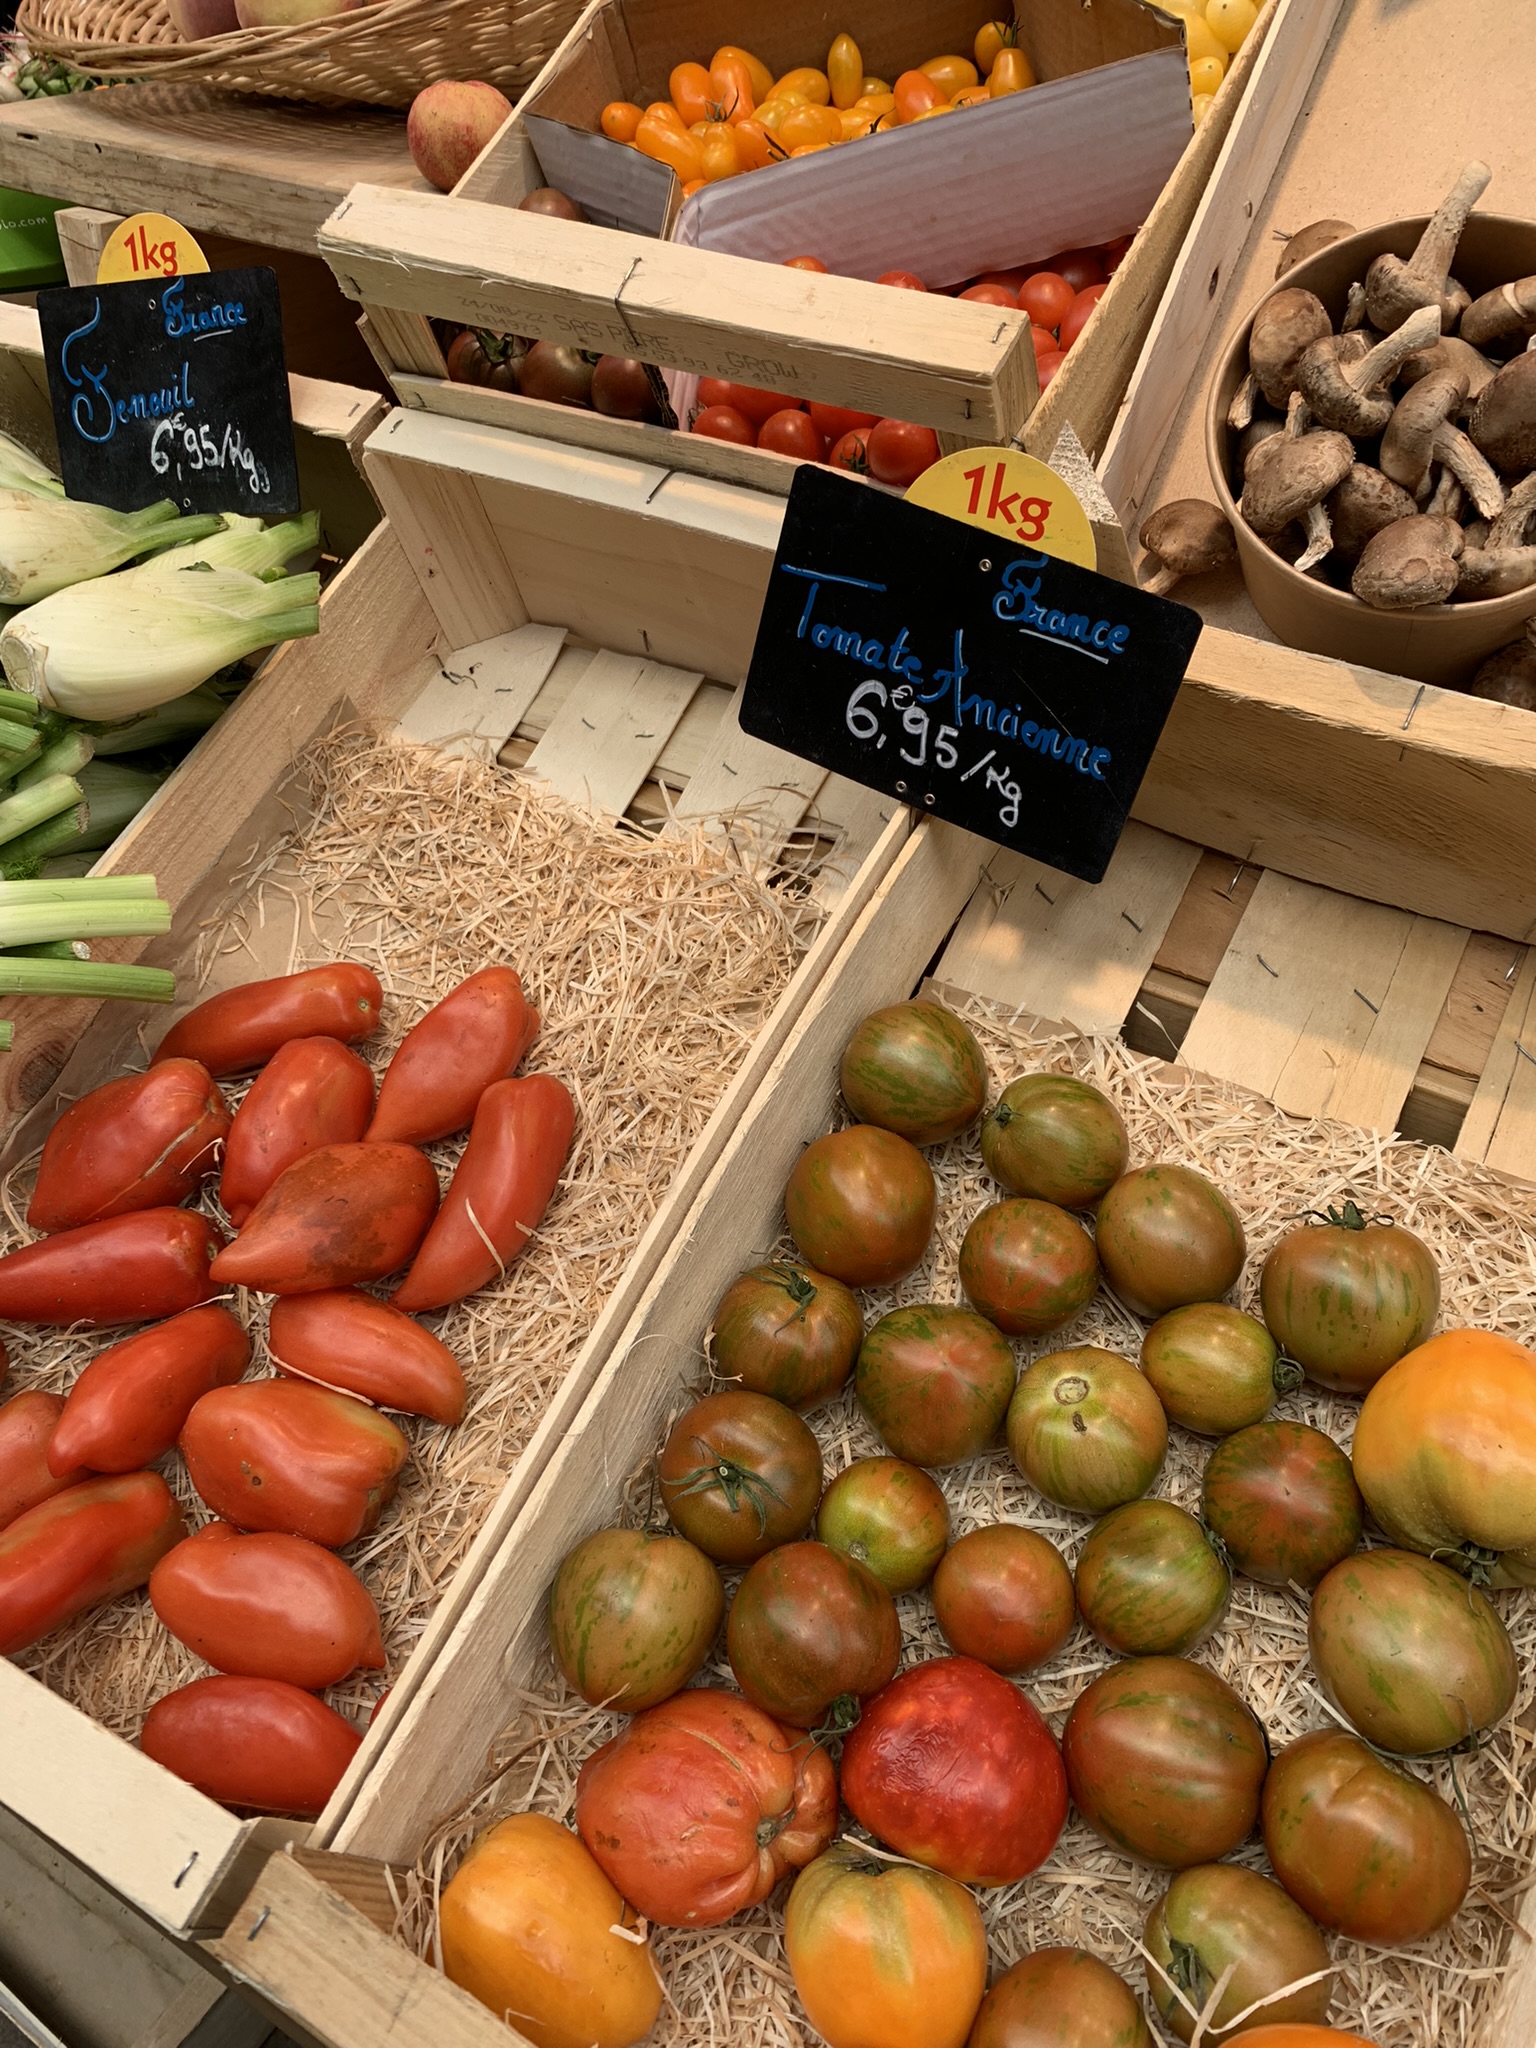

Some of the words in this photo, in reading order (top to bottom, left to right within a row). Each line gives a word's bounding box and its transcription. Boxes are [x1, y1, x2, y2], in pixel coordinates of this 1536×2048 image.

[123, 225, 178, 277] 1kg
[162, 275, 248, 338] France
[553, 314, 603, 338] SAS
[725, 351, 799, 380] GROW
[963, 462, 1053, 542] 1kg
[992, 555, 1130, 654] France
[781, 564, 925, 683] Tomate
[917, 628, 1112, 780] Ancienne
